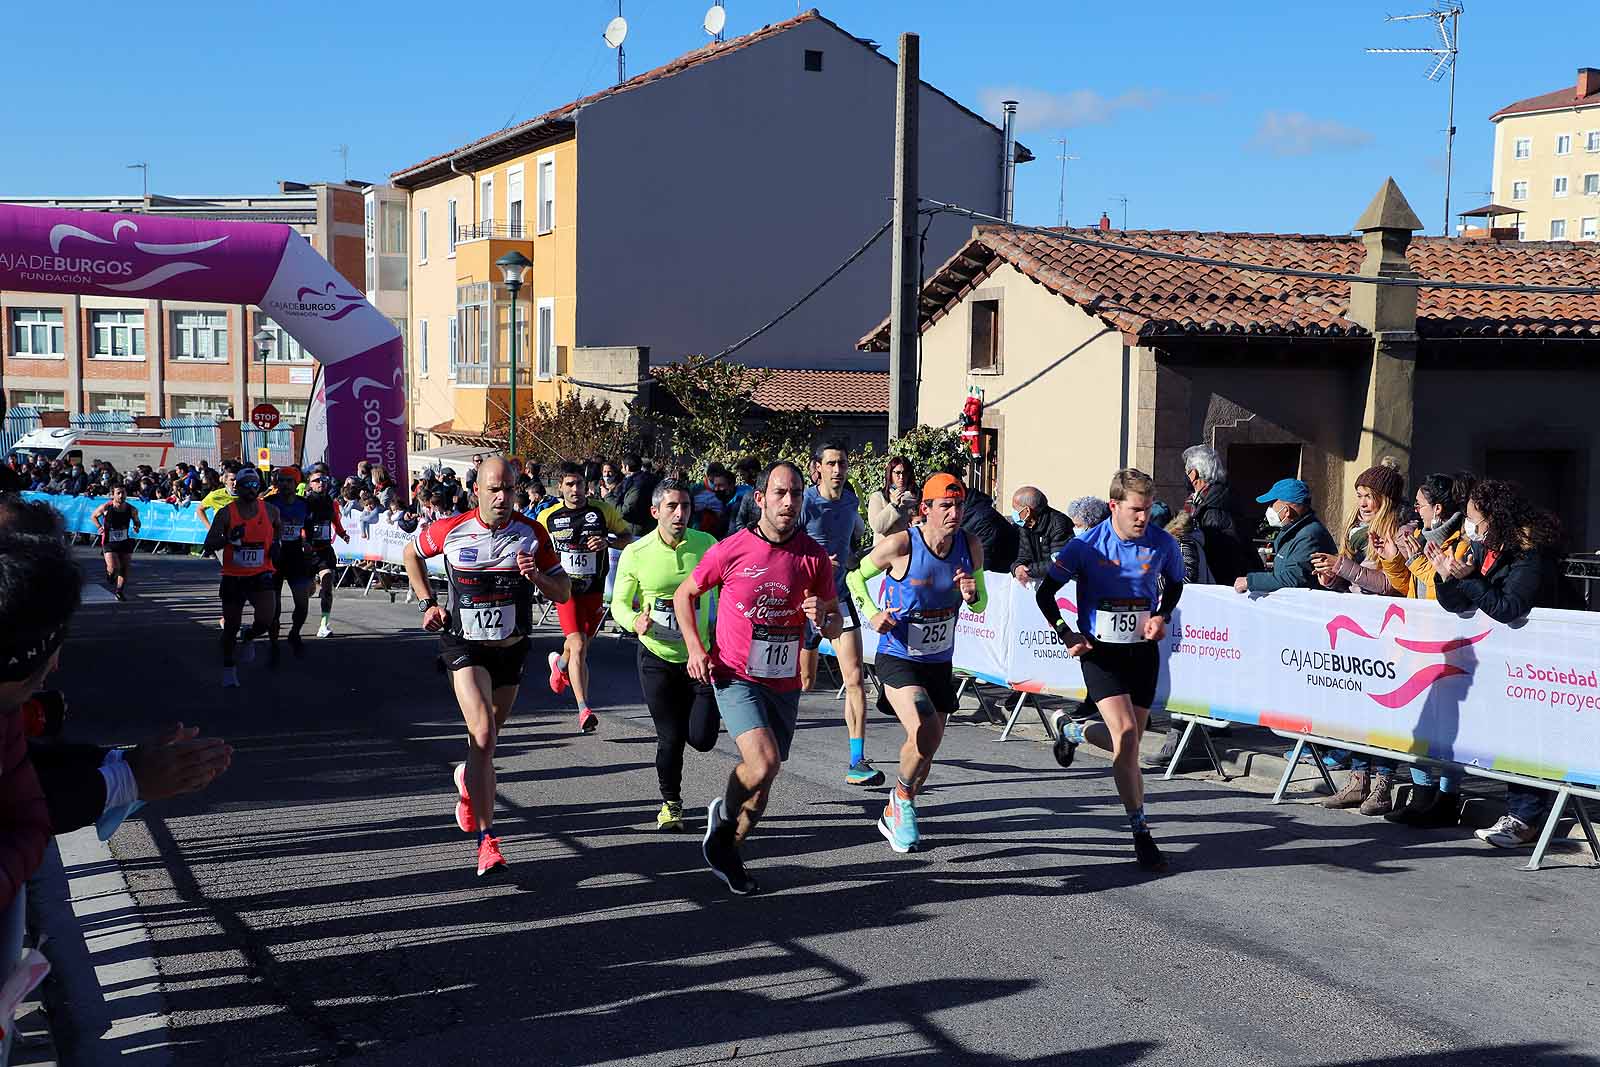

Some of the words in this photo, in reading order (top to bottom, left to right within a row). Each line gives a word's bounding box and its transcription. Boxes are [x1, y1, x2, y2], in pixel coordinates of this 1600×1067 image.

[20, 271, 92, 284] FUNDACIÓN
[270, 301, 336, 311] CAJADEBURGOS
[254, 413, 278, 421] STOP
[569, 554, 588, 567] 145
[474, 609, 504, 629] 122
[1110, 614, 1137, 632] 159
[922, 623, 947, 644] 252
[1172, 624, 1182, 638] La
[1185, 624, 1229, 641] Sociedad
[765, 644, 789, 666] 118
[1171, 643, 1197, 654] como
[1199, 645, 1241, 661] proyecto
[1280, 648, 1396, 680] CAJADEBURGOS
[1306, 673, 1362, 692] FUNDACIÓN
[1505, 660, 1524, 678] La
[1525, 664, 1598, 688] Sociedad
[1507, 685, 1547, 701] como
